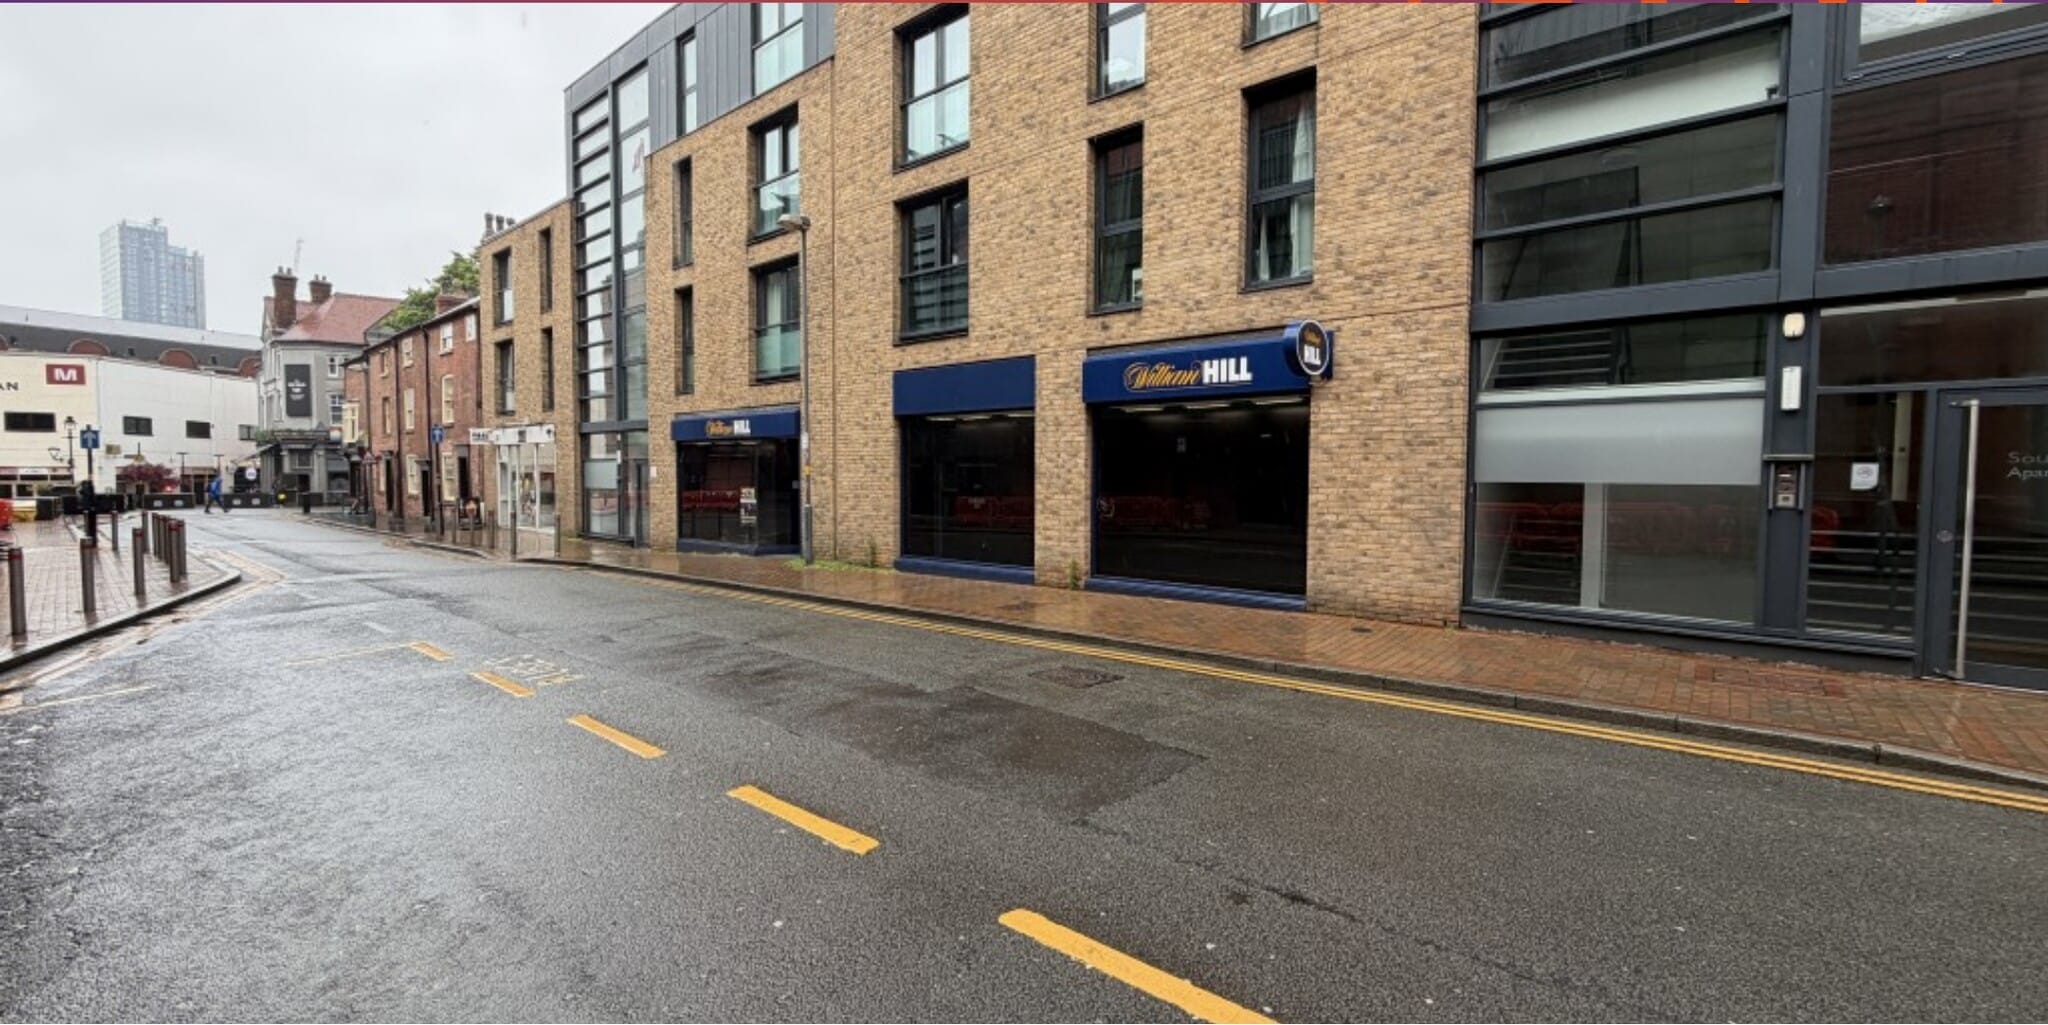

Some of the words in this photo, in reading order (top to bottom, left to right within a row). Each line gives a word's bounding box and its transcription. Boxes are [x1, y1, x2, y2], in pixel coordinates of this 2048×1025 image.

[54, 367, 78, 382] M
[1124, 361, 1201, 392] William
[1202, 356, 1253, 385] HILL
